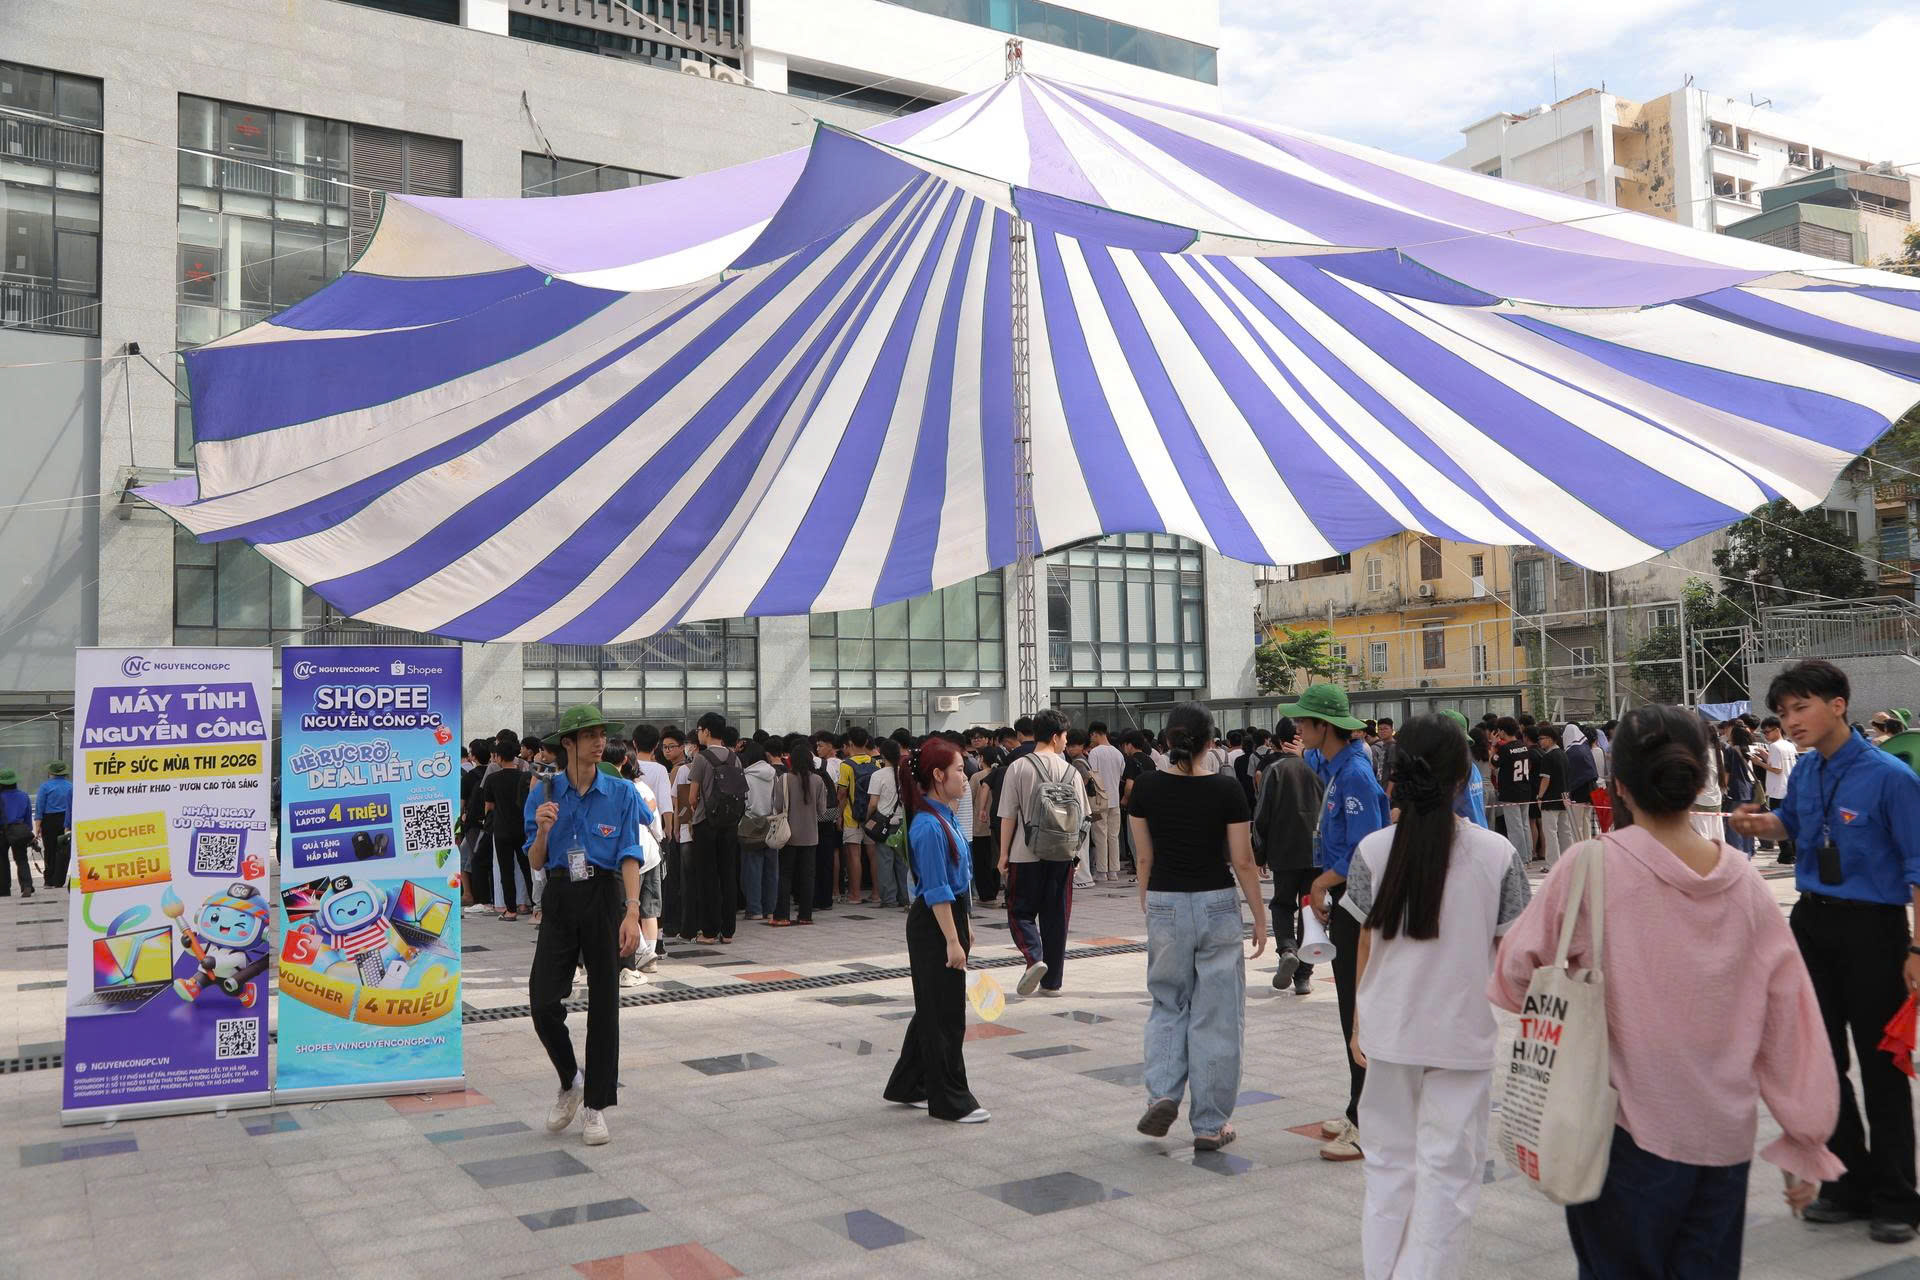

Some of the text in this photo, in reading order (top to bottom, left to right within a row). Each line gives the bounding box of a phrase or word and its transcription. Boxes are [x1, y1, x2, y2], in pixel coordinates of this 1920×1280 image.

[154, 663, 231, 671] NGUYENCONGPC
[407, 664, 443, 677] Shopee
[109, 685, 246, 714] MÁY TÍNH
[317, 687, 429, 710] SHOPEE
[85, 713, 263, 744] NGUYỄN CÔNG
[304, 711, 441, 728] NGUYỄN CÔNG PC
[93, 752, 257, 776] TIẾP SỨC MÙA THI 2026
[290, 739, 390, 773] HÈ RỰC RỠ
[308, 752, 453, 790] DEAL HẾT CỠ
[102, 785, 125, 796] TRỌN
[127, 782, 148, 794] KHÁT
[150, 783, 171, 793] KHAO
[203, 782, 219, 790] CAO
[182, 804, 255, 819] NHẬN NGAY
[294, 807, 326, 817] VOUCHER
[329, 802, 388, 822] 4 TRIỆU
[218, 820, 266, 831] SHOPEE
[296, 816, 326, 827] LAPTOP
[85, 823, 156, 843] VOUCHER
[302, 838, 340, 850] QUÀ TẶNG
[87, 857, 161, 881] 4 TRIỆU
[279, 966, 343, 1003] VOUCHER
[364, 989, 449, 1017] 4 TRIỆU
[295, 1036, 446, 1054] SHOPEE.VN/NGUYENCONGPC.VN
[91, 1057, 170, 1071] NGUYENCONGPC.VN
